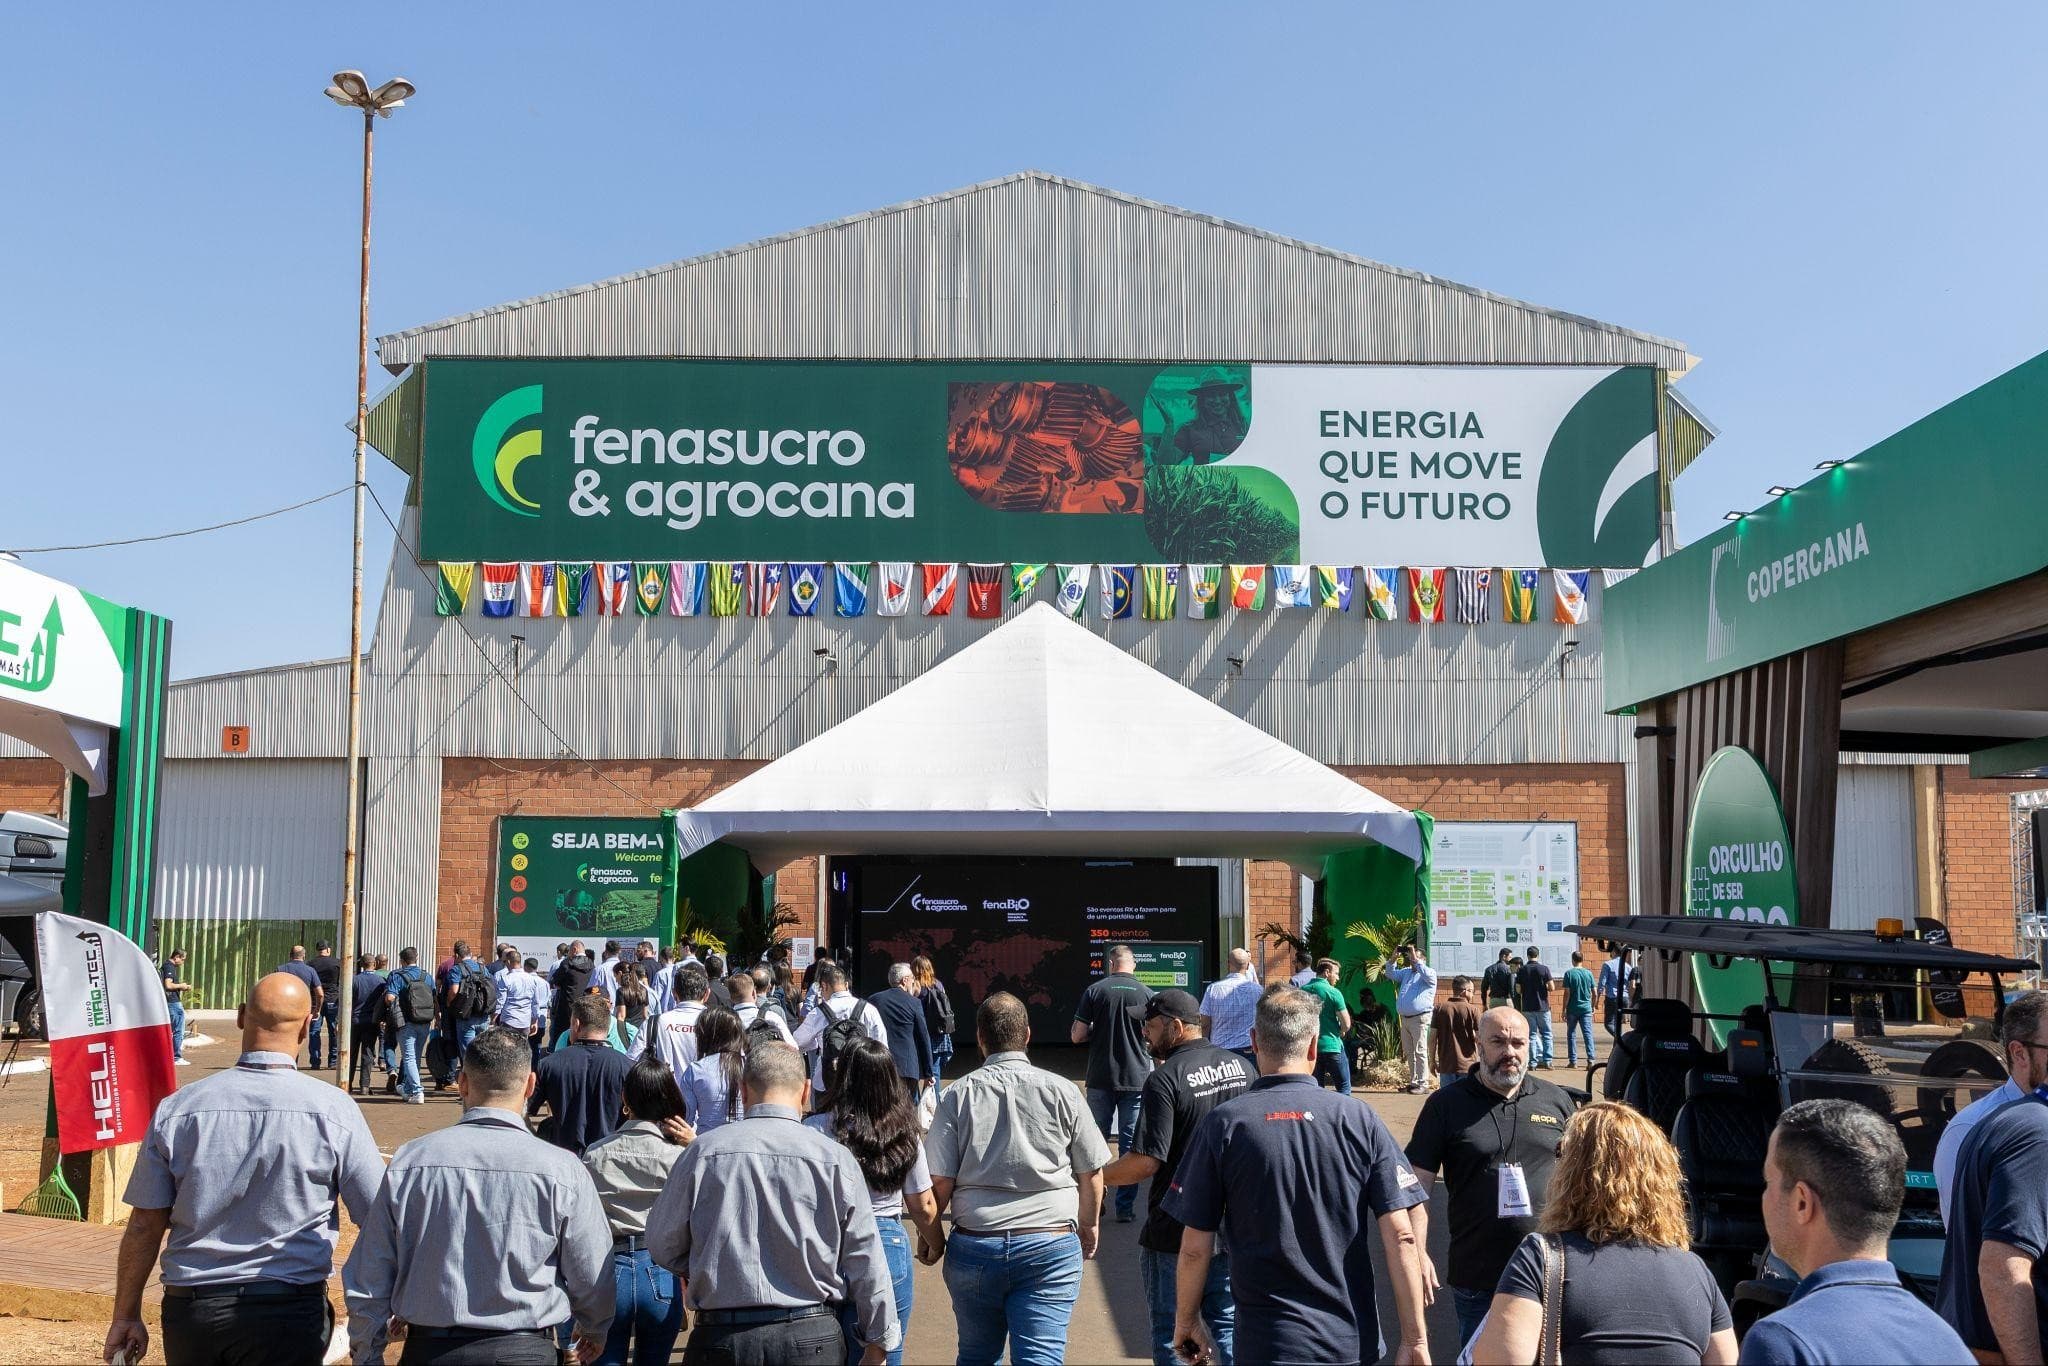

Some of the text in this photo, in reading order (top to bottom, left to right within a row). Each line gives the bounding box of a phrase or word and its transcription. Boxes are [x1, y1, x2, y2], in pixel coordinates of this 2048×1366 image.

[1320, 410, 1484, 438] ENERGIA
[569, 415, 866, 466] fenasucro
[1319, 450, 1522, 483] QUE MOVE
[569, 468, 915, 530] & agrocana
[1320, 491, 1511, 520] O FUTURO
[1747, 522, 1869, 603] COPERCANA
[232, 733, 240, 746] B
[551, 832, 601, 849] SEJA
[615, 852, 662, 862] Welcome
[1709, 840, 1784, 875] ORGULHO
[590, 867, 632, 876] fenasucro
[590, 875, 639, 885] & agrocana
[921, 897, 959, 905] fenasucro
[1712, 882, 1743, 900] DE SER
[930, 904, 968, 912] agrocana
[1090, 929, 1150, 937] 350 eventos
[1090, 960, 1102, 968] 41
[86, 949, 104, 1027] MAQ-TEC
[86, 1001, 94, 1027] GRUPO
[109, 1045, 118, 1085] AUTORIZADO
[87, 1042, 116, 1141] HELI
